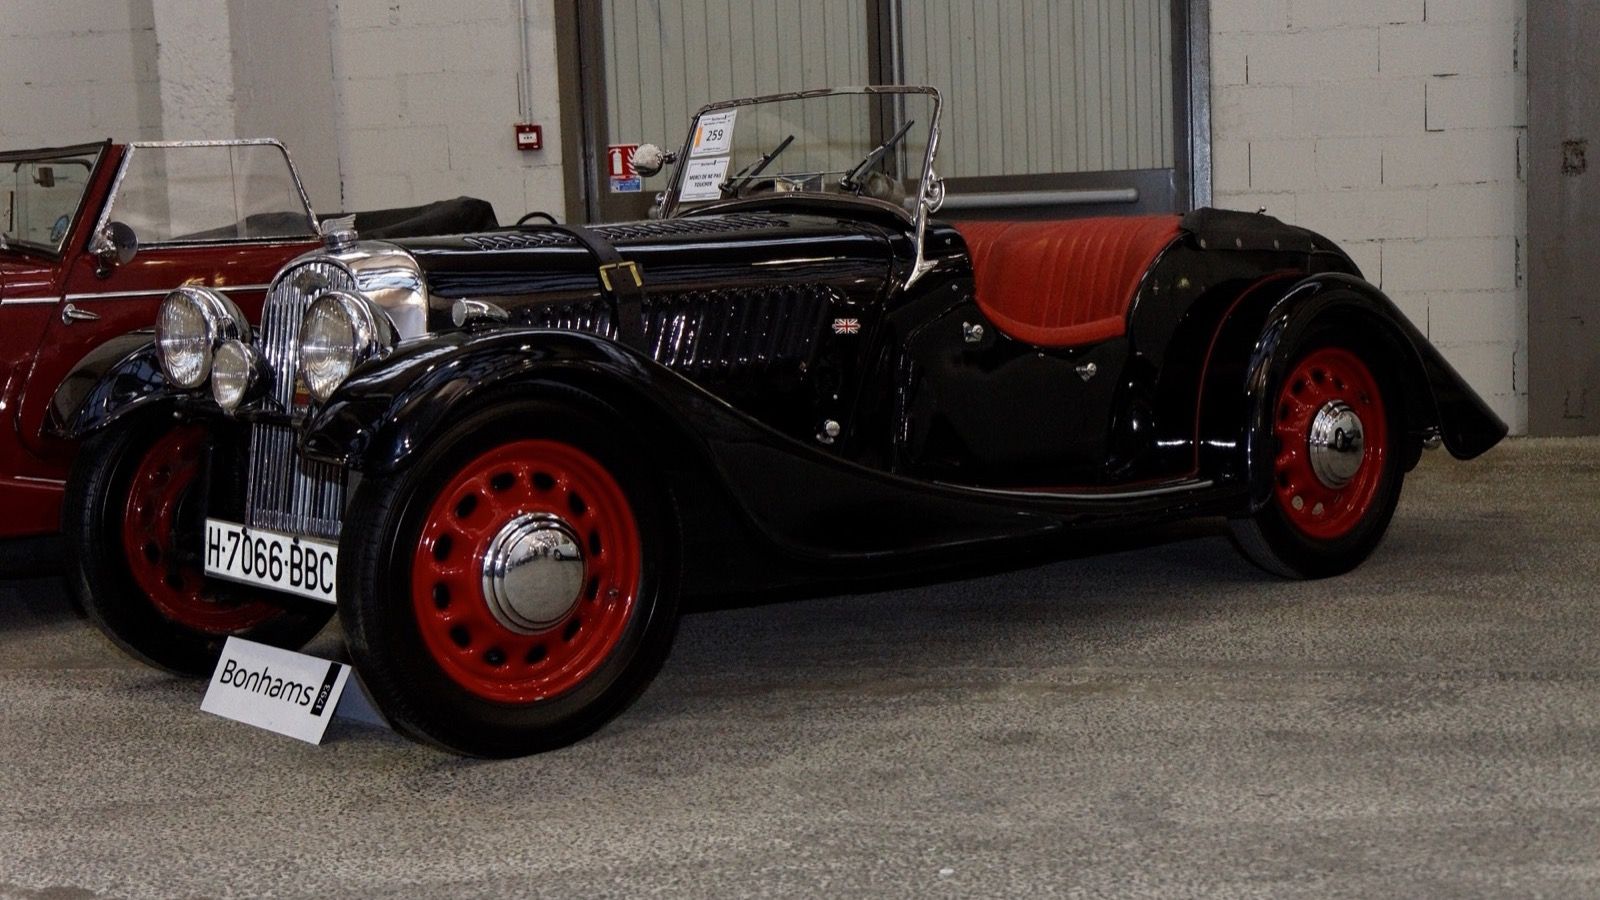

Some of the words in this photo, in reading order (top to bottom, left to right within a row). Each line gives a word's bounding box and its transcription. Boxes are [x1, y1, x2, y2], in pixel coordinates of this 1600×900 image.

[706, 129, 723, 142] 259
[220, 659, 314, 706] Bonhams
[315, 684, 331, 709] 1793
